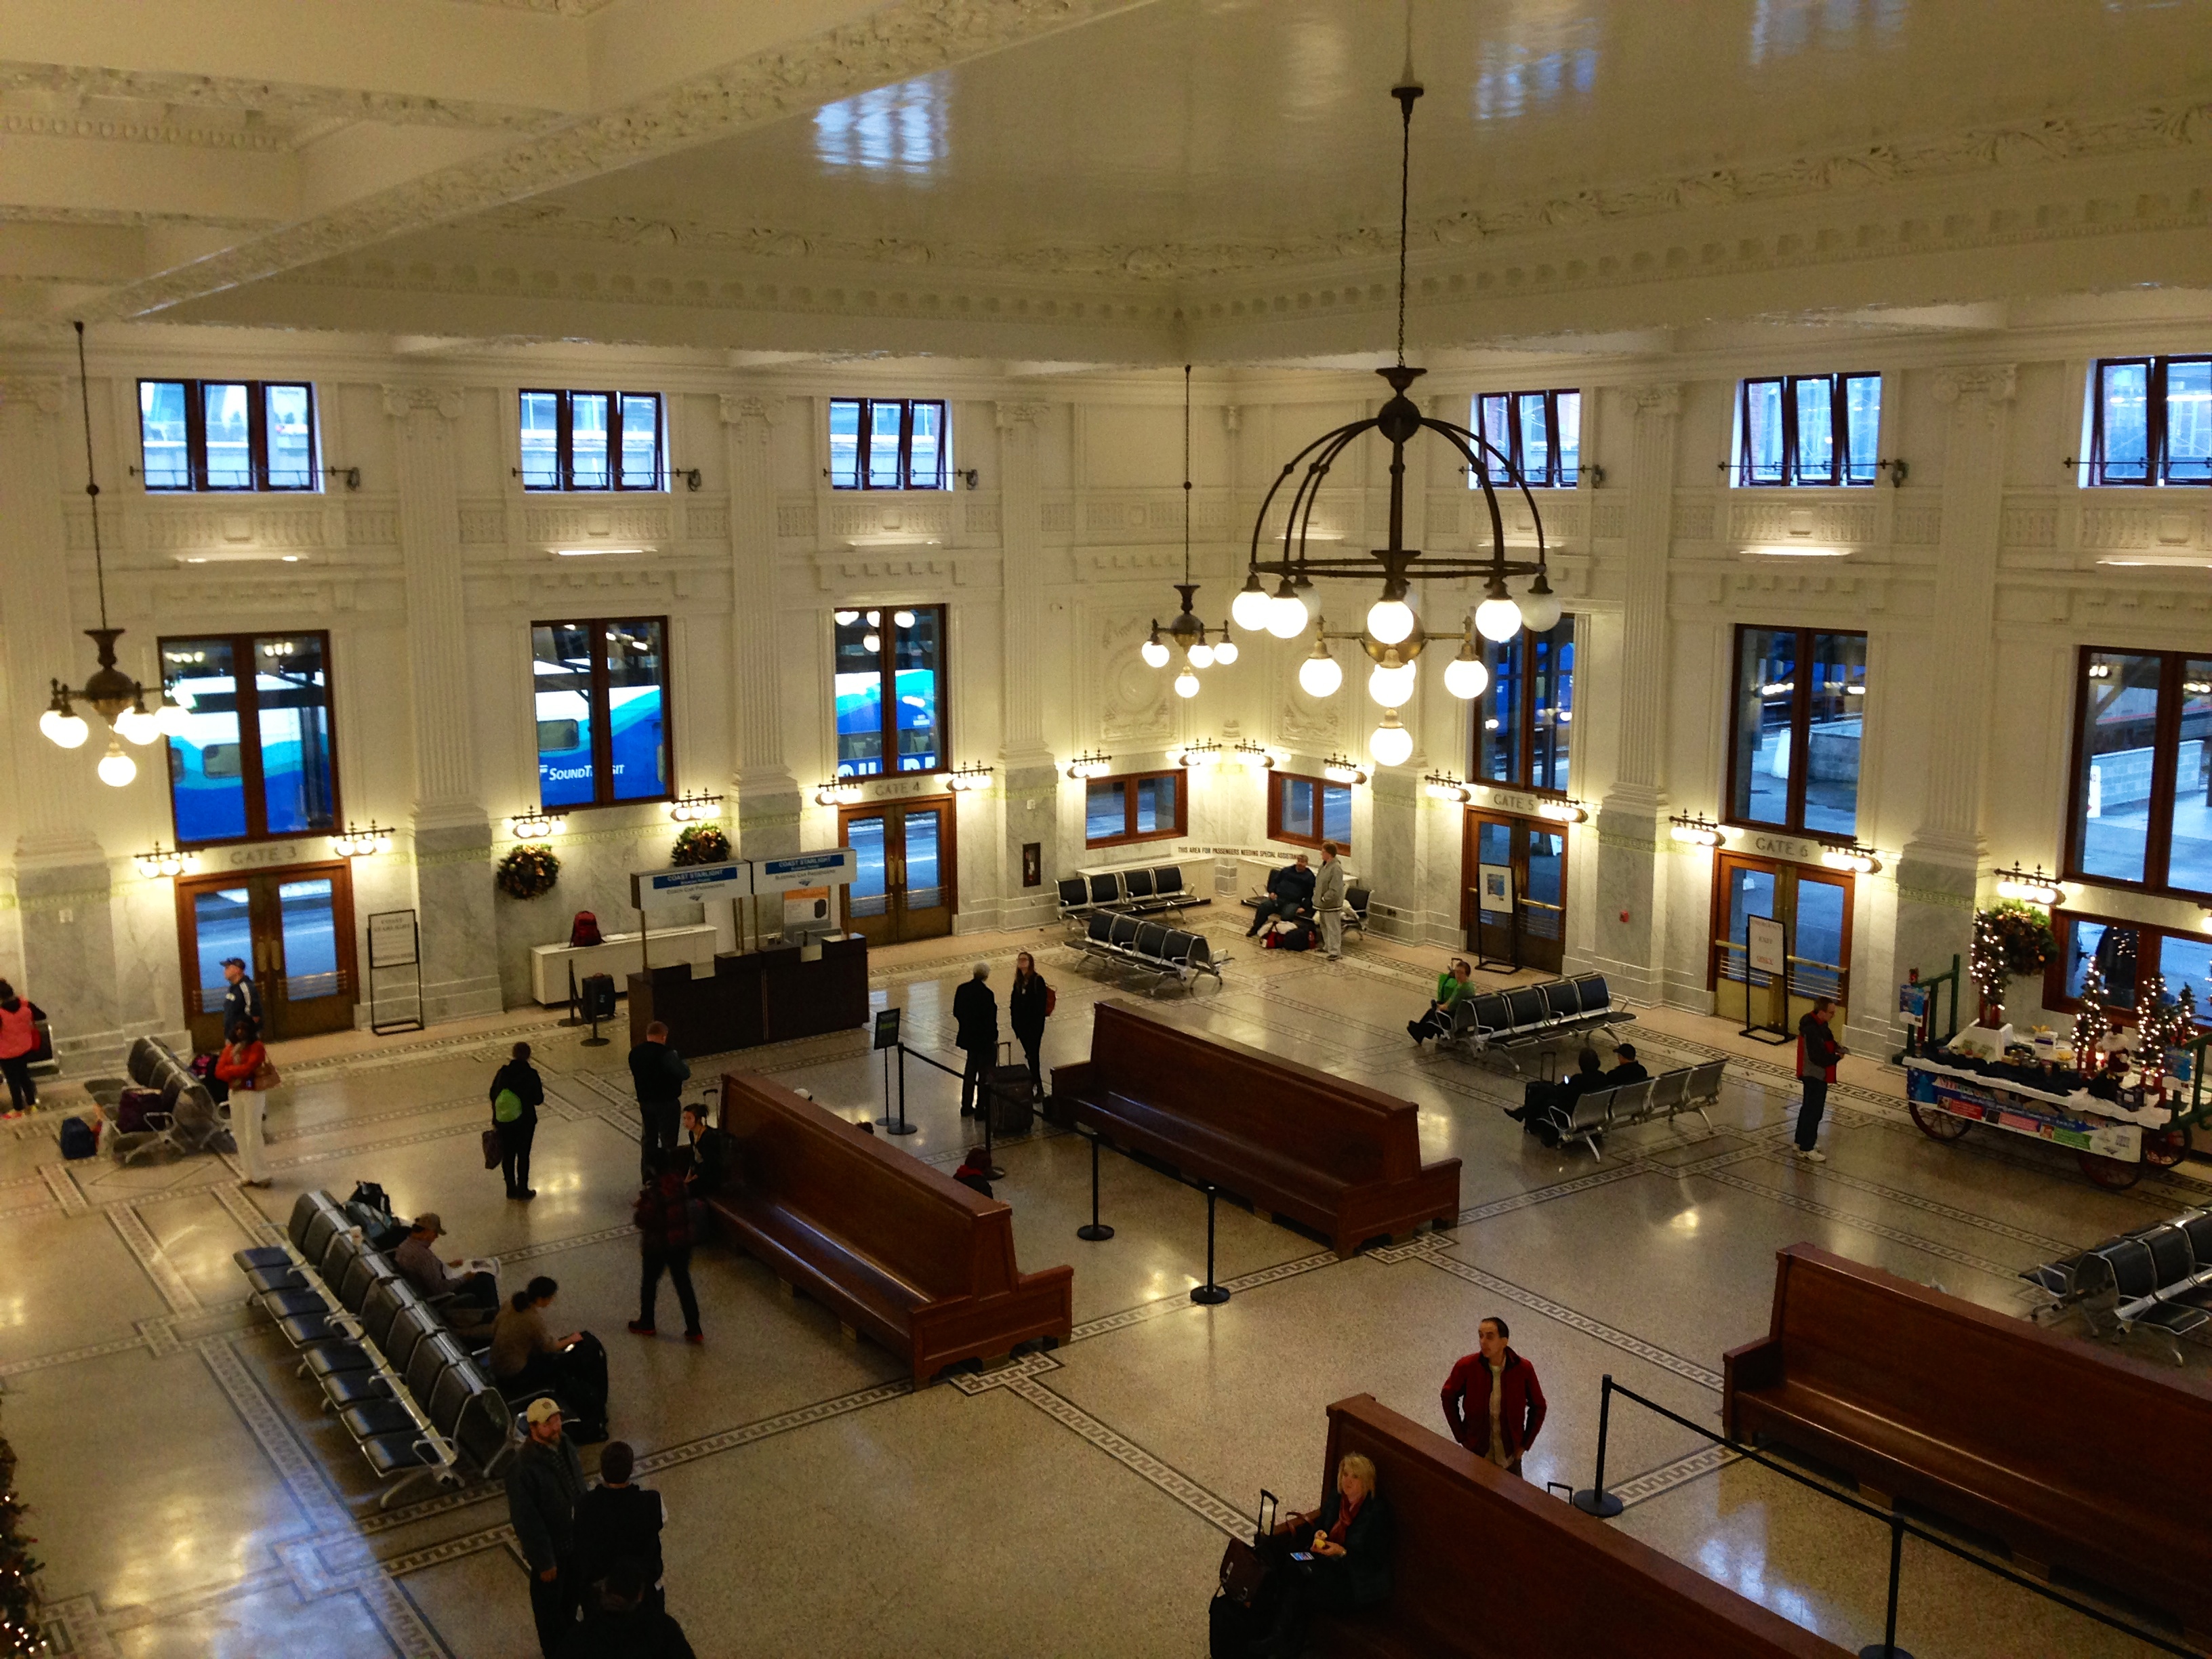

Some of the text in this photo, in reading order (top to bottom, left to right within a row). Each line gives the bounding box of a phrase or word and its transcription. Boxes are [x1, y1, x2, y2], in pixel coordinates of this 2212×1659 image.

[875, 781, 921, 796] GATE 4
[1494, 794, 1534, 811] GATE 5
[1212, 847, 1240, 855] PASSENGERS
[1755, 837, 1808, 857] GATE 6
[230, 846, 297, 865] GATE 3
[778, 859, 799, 868] COAST
[800, 855, 832, 865] STARLIGHT
[667, 873, 689, 882] COAST
[689, 869, 723, 879] STARLIGHT
